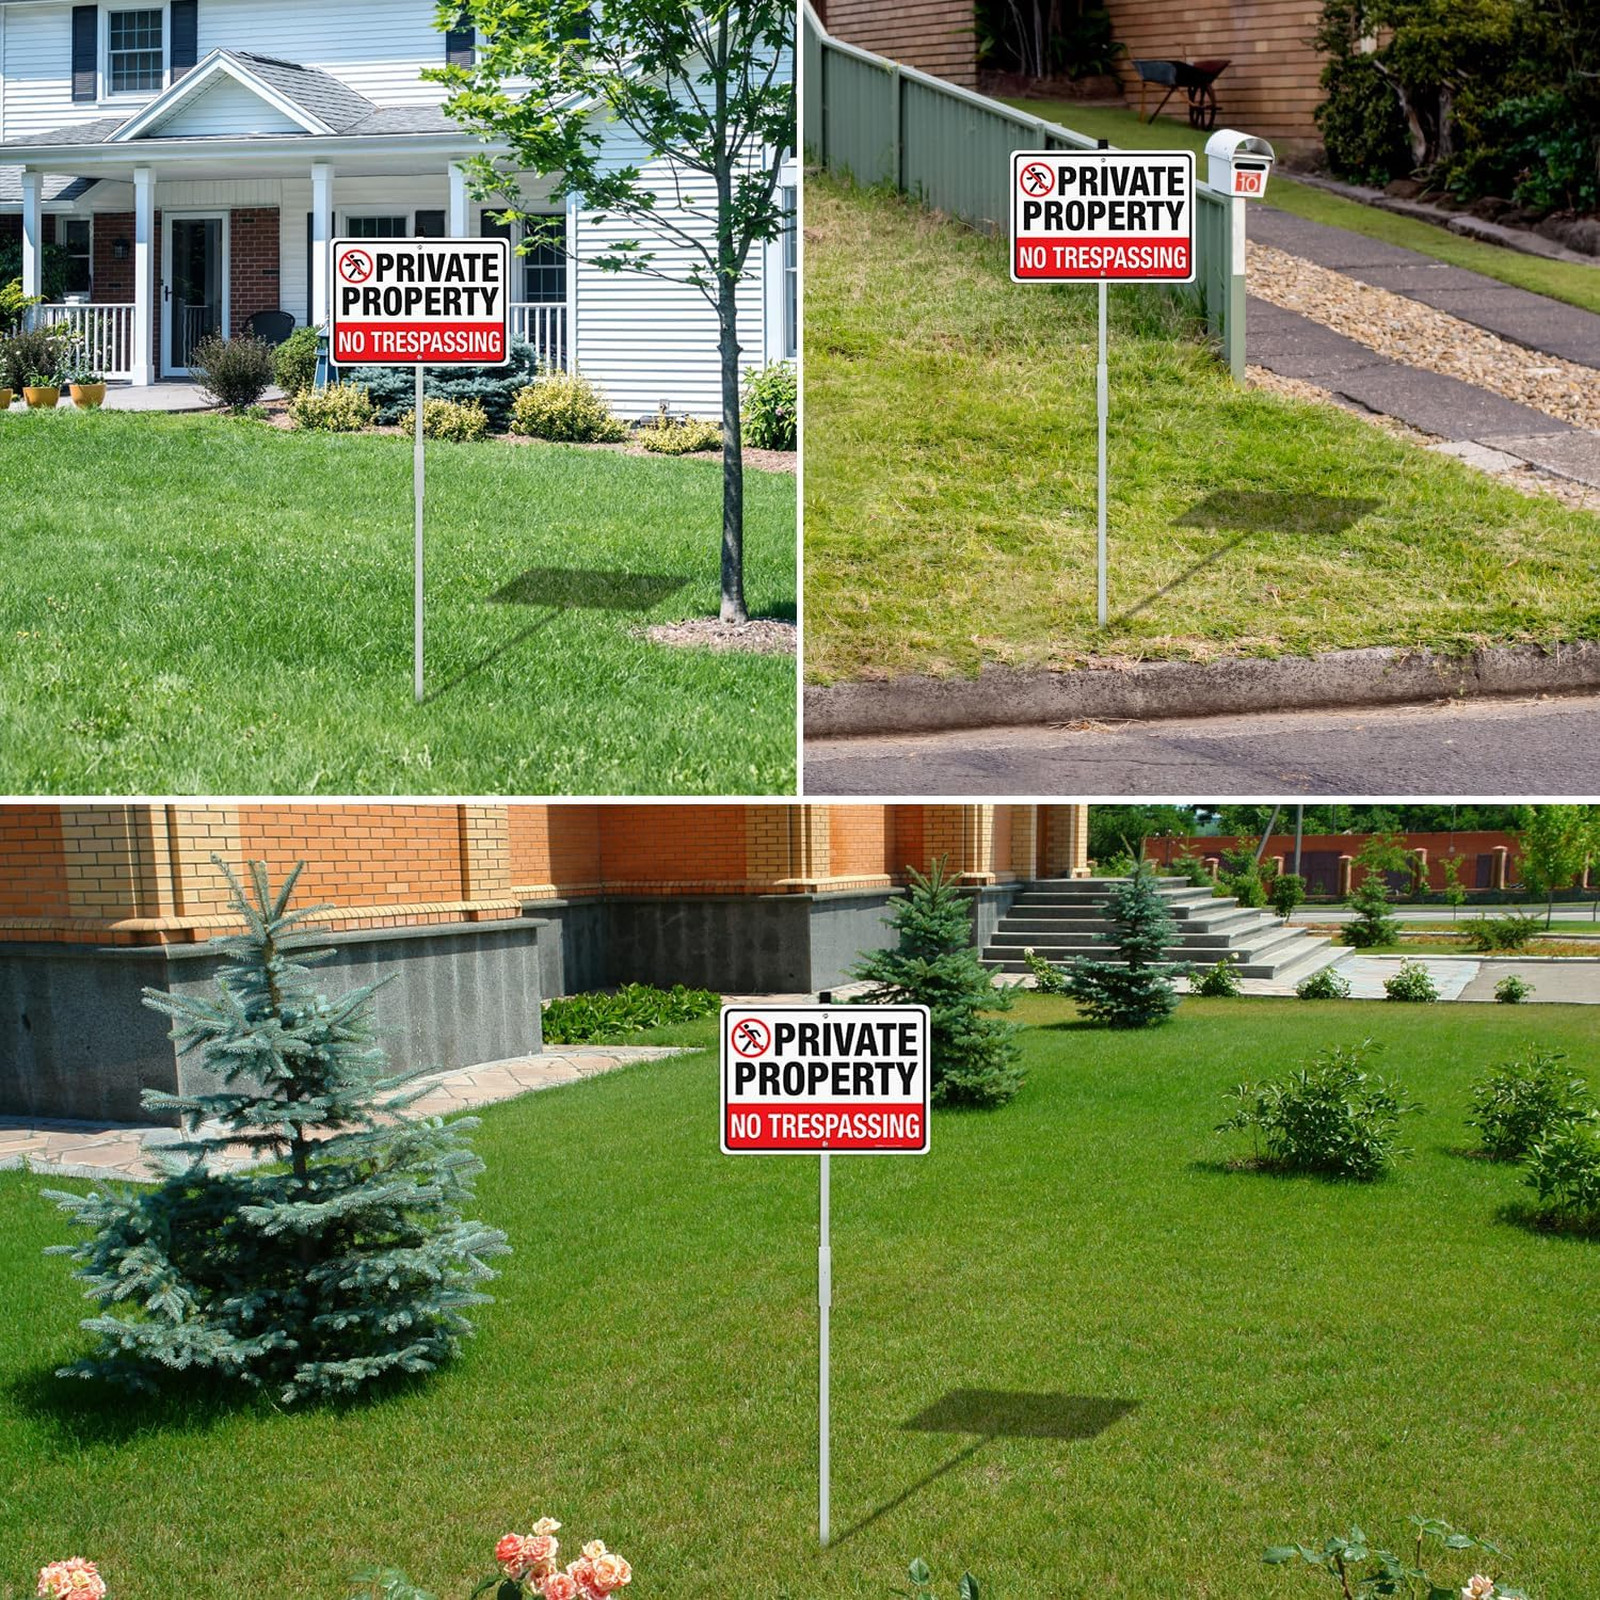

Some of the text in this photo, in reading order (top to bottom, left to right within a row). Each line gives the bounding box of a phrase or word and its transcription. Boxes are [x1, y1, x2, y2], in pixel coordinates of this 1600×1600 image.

[1058, 166, 1185, 196] PRIVATE
[1238, 176, 1258, 192] 10
[1023, 200, 1185, 231] PROPERTY
[376, 253, 499, 282] PRIVATE
[1019, 246, 1187, 269] NO TRESPASSING
[342, 286, 499, 316] PROPERTY
[338, 331, 501, 353] NO TRESPASSING
[774, 1022, 918, 1057] PRIVATE
[735, 1061, 918, 1096] PROPERTY
[730, 1113, 920, 1139] NO TRESPASSING
